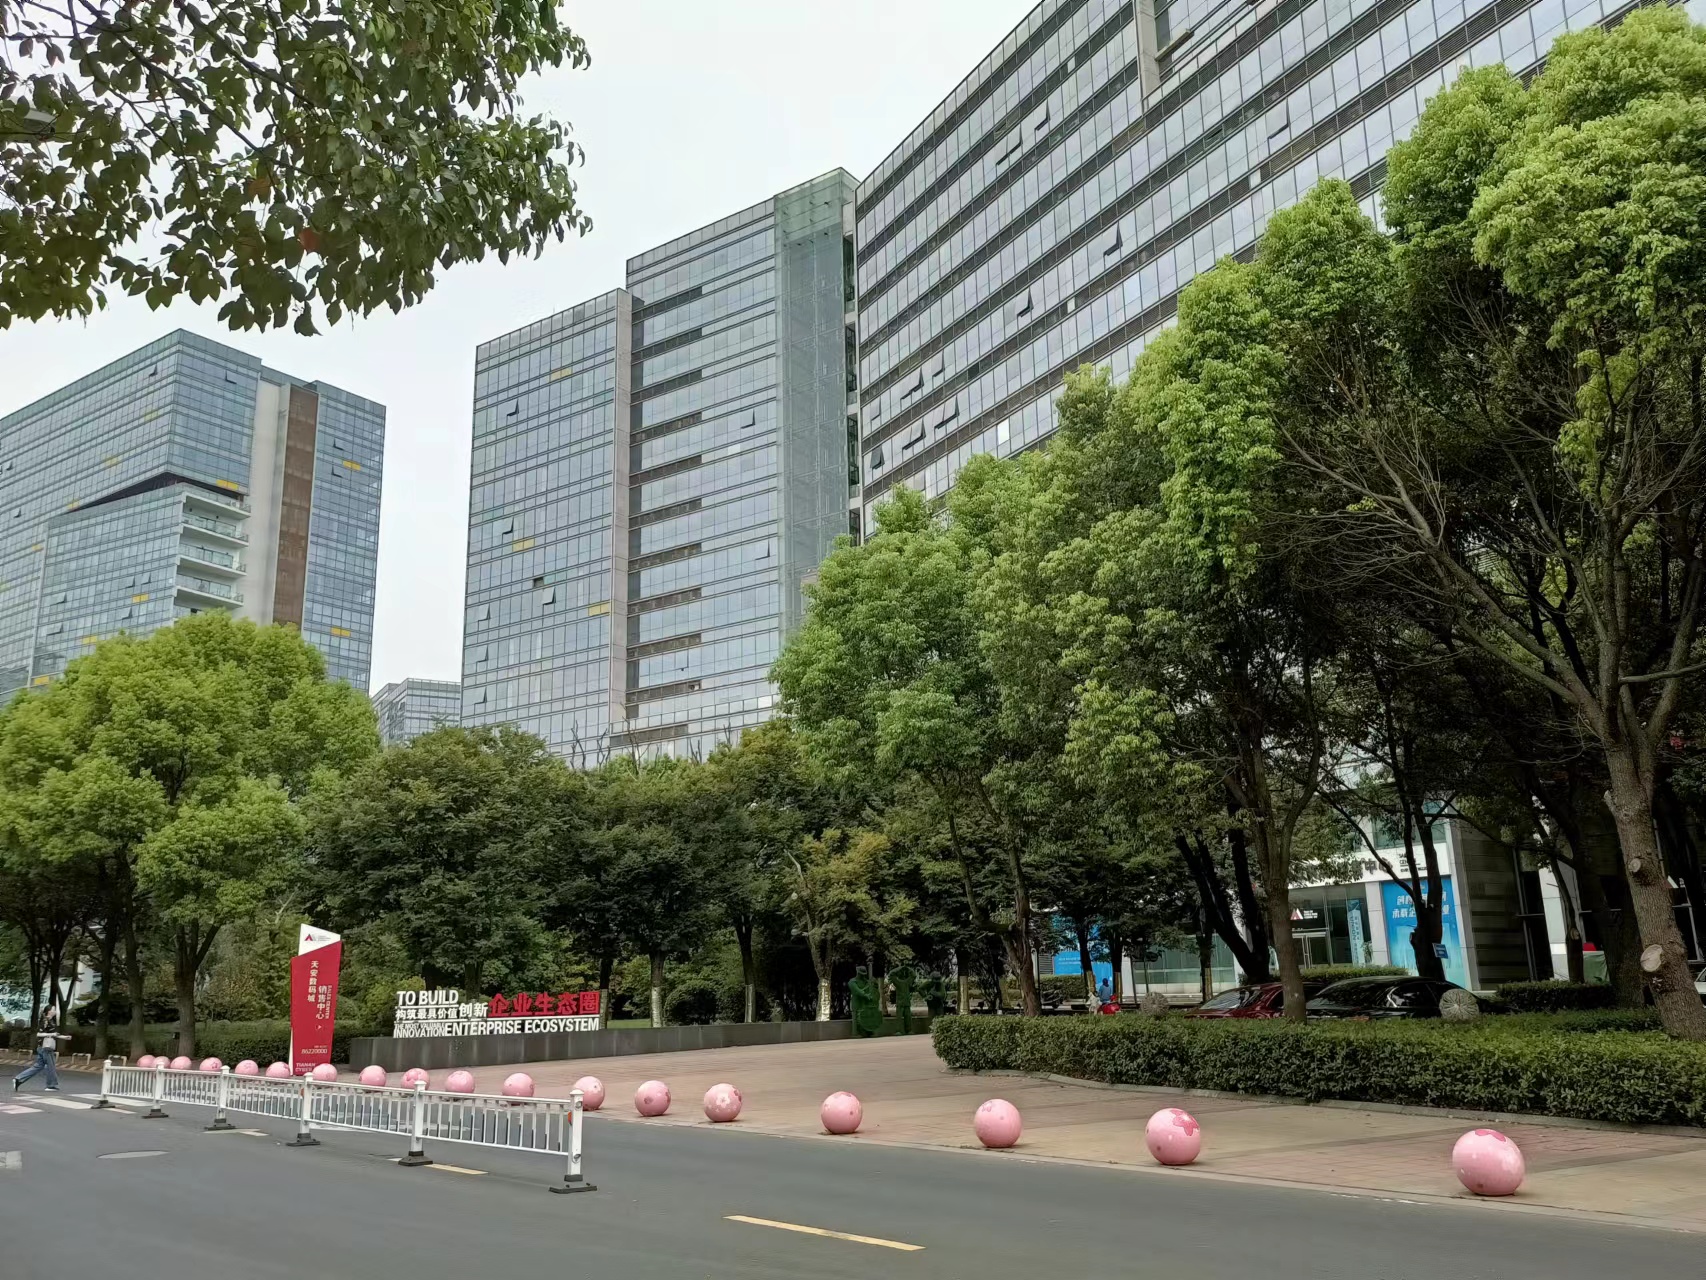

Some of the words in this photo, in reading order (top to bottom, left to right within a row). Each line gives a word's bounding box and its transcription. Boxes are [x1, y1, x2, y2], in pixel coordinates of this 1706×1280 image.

[316, 985, 327, 1020] 销售中心
[395, 1007, 457, 1021] 构筑最具价值
[459, 1002, 488, 1017] 创新
[489, 992, 600, 1017] 企业生态圈
[396, 991, 416, 1006] TO
[419, 990, 459, 1004] BUILD
[393, 1028, 444, 1038] INNOVATION
[445, 1020, 521, 1036] ENTERPRISE
[524, 1018, 599, 1034] ECOSYSTEM
